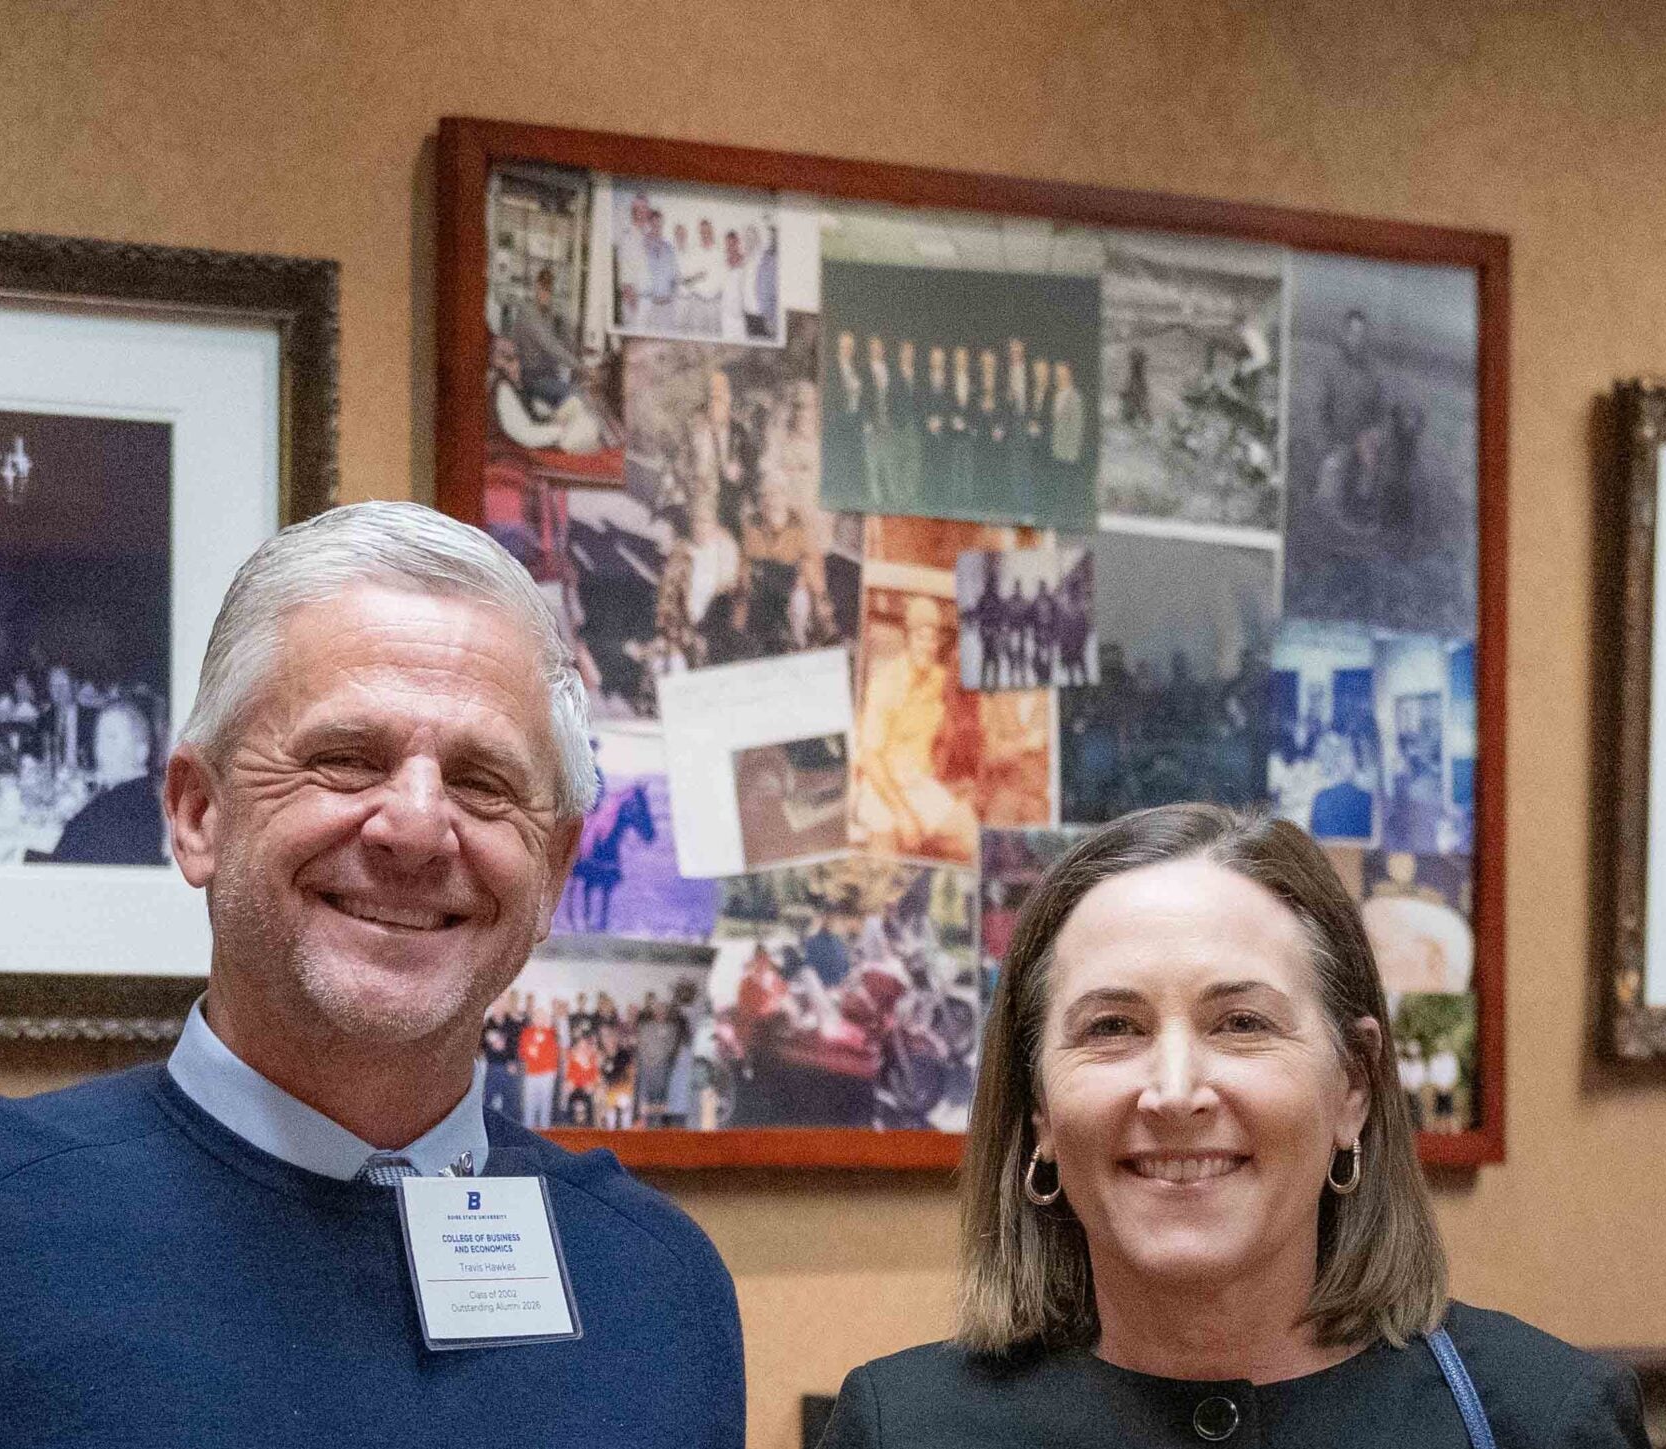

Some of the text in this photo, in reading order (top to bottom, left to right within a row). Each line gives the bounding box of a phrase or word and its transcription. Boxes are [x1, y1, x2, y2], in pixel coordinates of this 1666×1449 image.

[466, 1191, 481, 1210] B
[442, 1233, 521, 1243] COLLEGE OF BUSINESS
[454, 1245, 513, 1253] AND ECONOMICS
[459, 1262, 516, 1272] Travis Hawkes
[469, 1291, 487, 1299] Class
[488, 1290, 497, 1298] of
[451, 1303, 494, 1313] Outstanding
